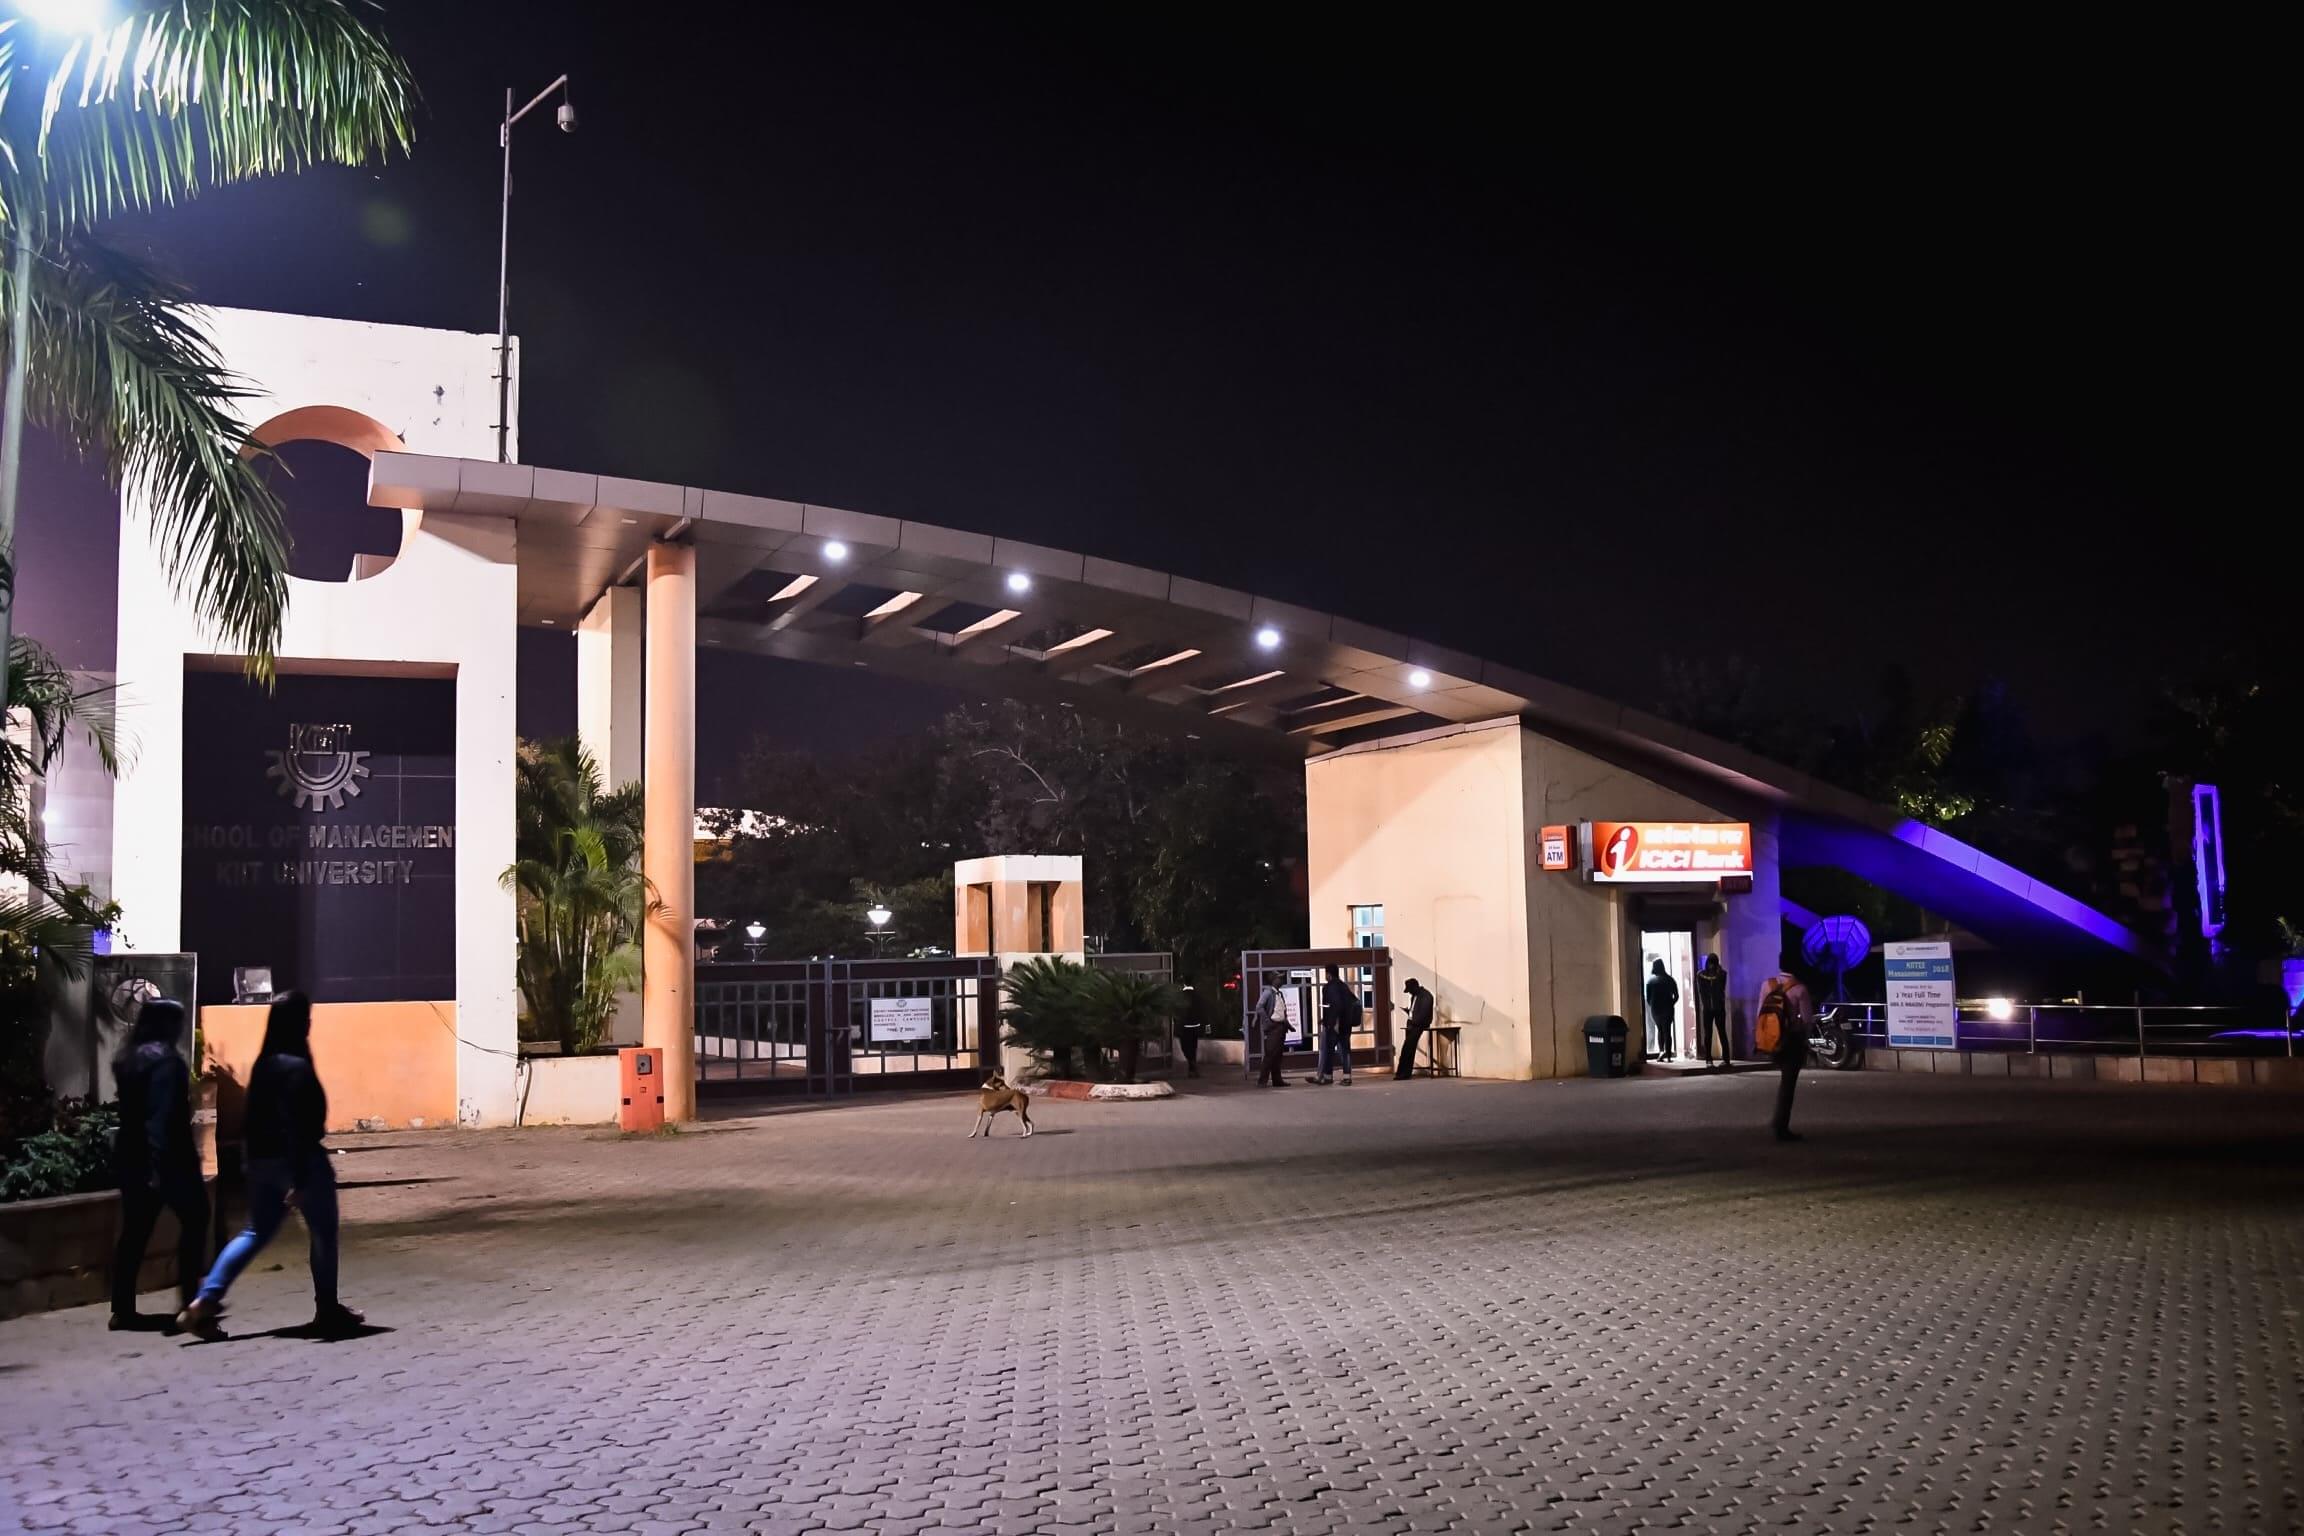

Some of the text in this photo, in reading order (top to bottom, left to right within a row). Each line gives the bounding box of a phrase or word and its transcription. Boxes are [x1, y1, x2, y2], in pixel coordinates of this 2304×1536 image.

[269, 824, 301, 848] OF
[308, 825, 456, 848] MANAGEMEN
[1547, 852, 1563, 861] ATM
[1639, 850, 1745, 868] ICICI Bank
[216, 860, 413, 884] KIIT UNIVERSITY
